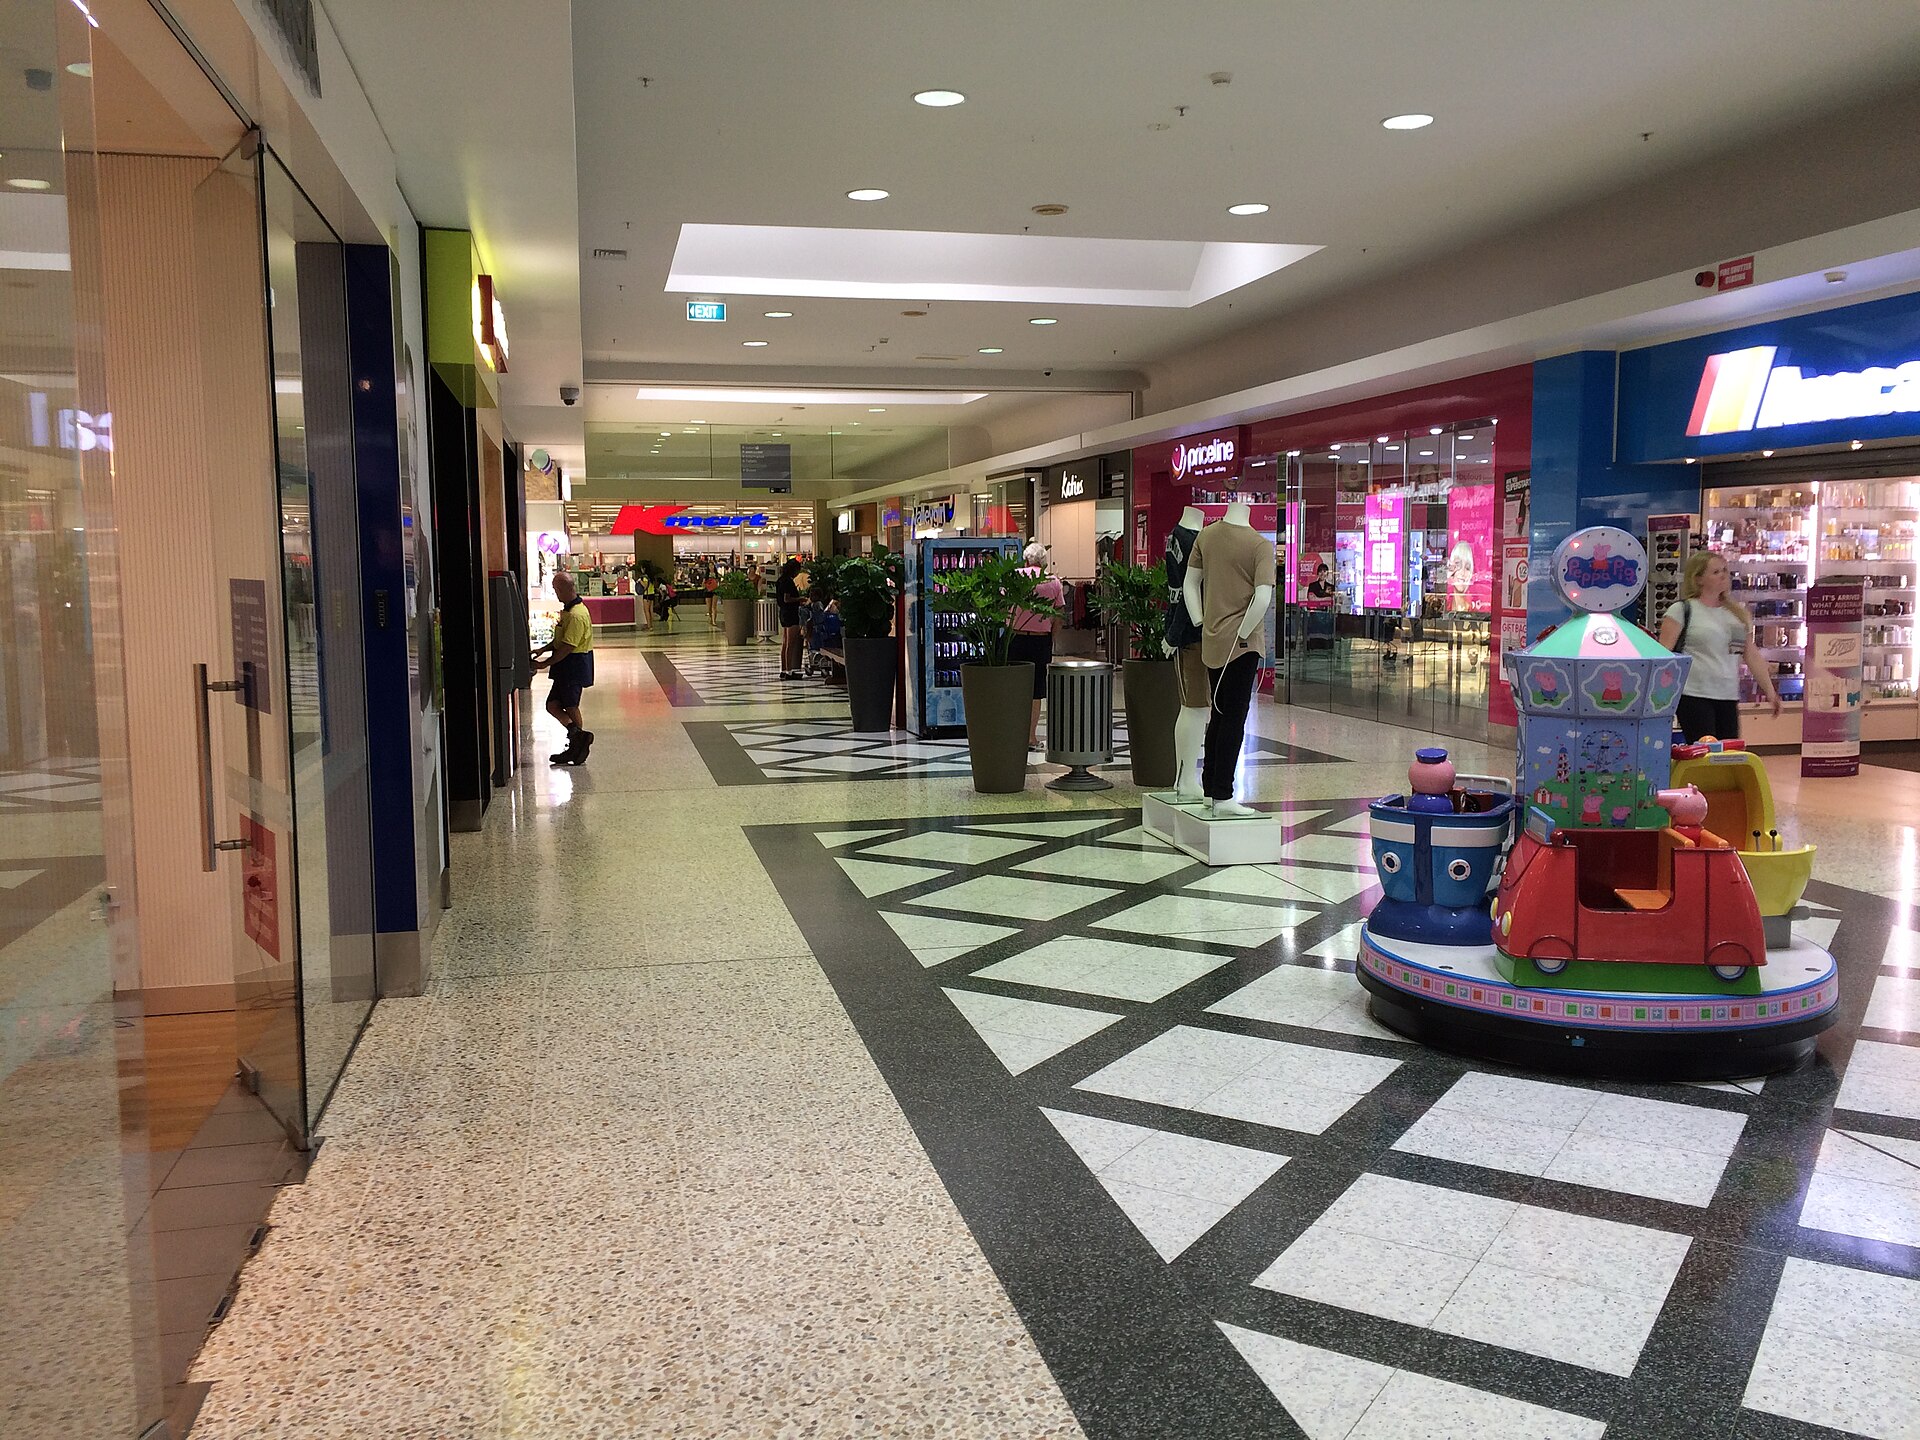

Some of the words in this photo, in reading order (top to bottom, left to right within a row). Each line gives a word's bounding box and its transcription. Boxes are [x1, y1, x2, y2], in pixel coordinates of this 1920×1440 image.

[695, 304, 719, 319] EXIT
[1187, 438, 1234, 473] priceline
[610, 505, 769, 535] Kmart
[1567, 559, 1611, 587] Peppa
[1613, 559, 1635, 586] Pig
